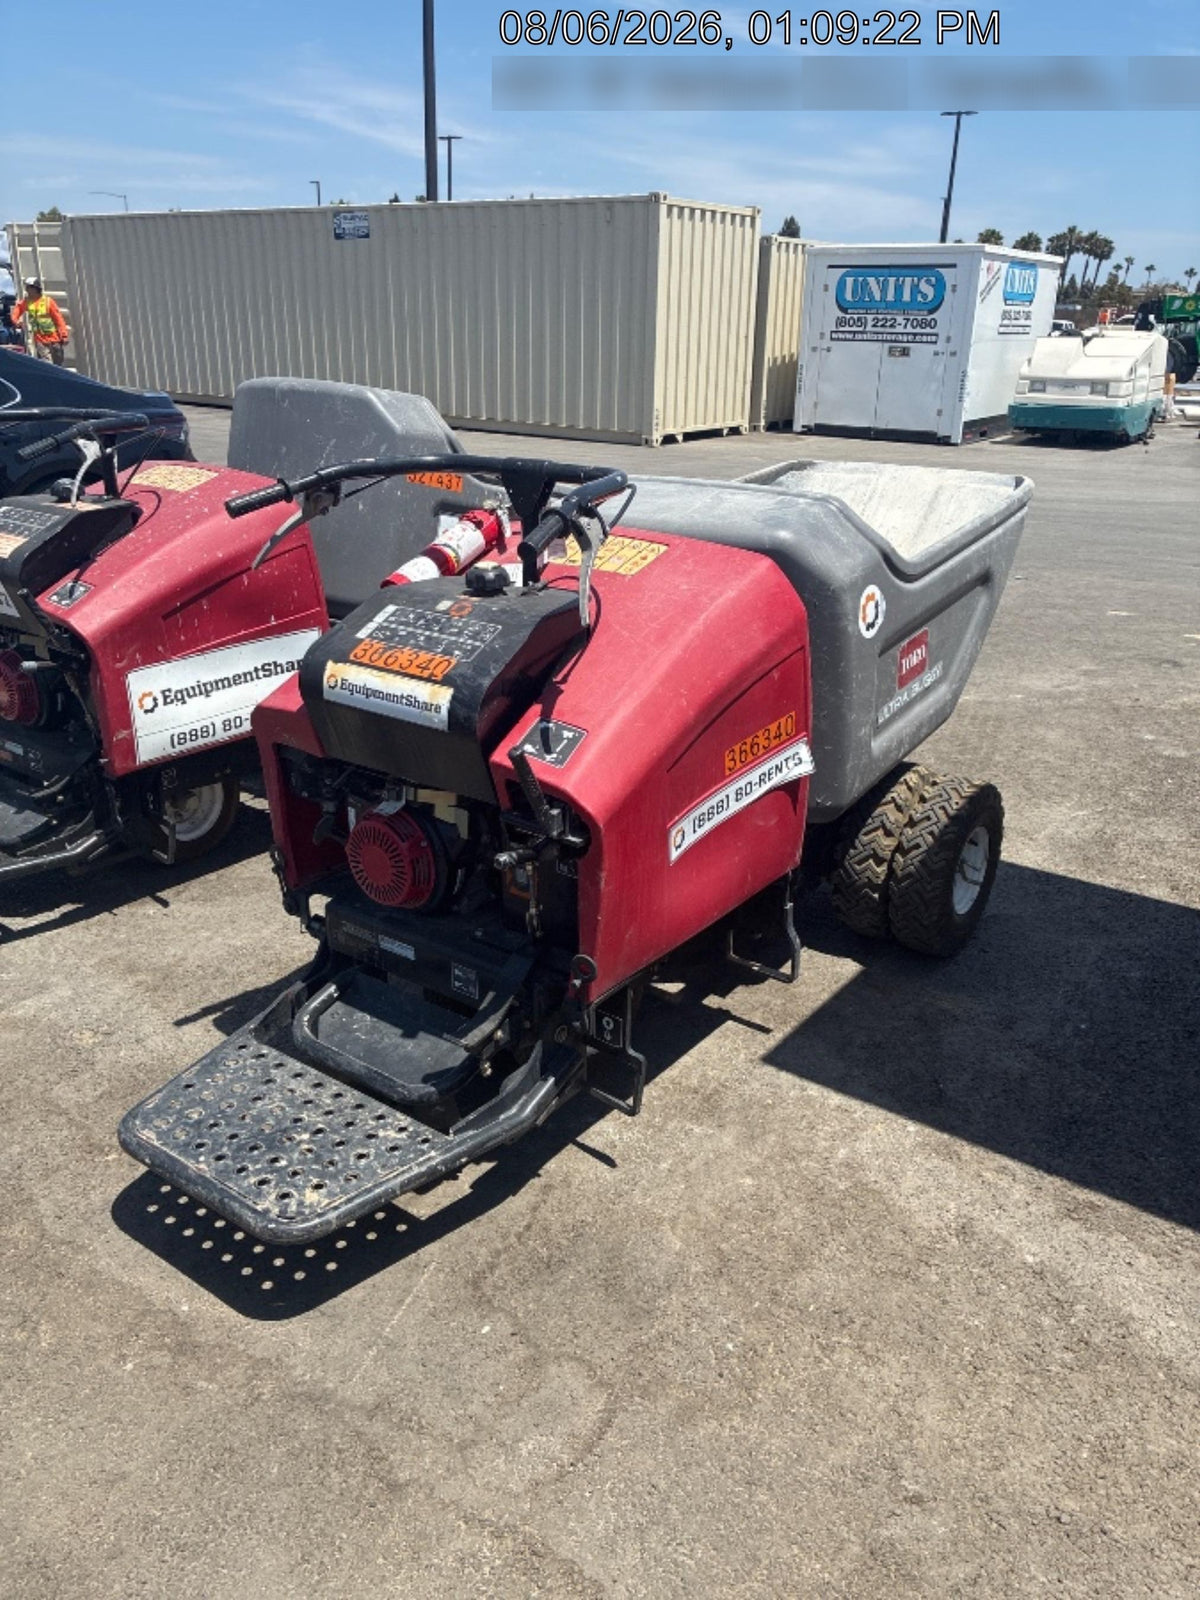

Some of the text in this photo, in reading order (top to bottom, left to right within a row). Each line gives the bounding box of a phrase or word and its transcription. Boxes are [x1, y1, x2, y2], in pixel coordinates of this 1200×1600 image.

[844, 276, 937, 303] UNITS
[835, 316, 938, 330] (805) 222-7080
[353, 641, 451, 681] 366340
[160, 658, 304, 707] EquipmentShar
[339, 678, 442, 714] EquipmentShare
[170, 721, 216, 748] (888)
[726, 713, 795, 772] 366340
